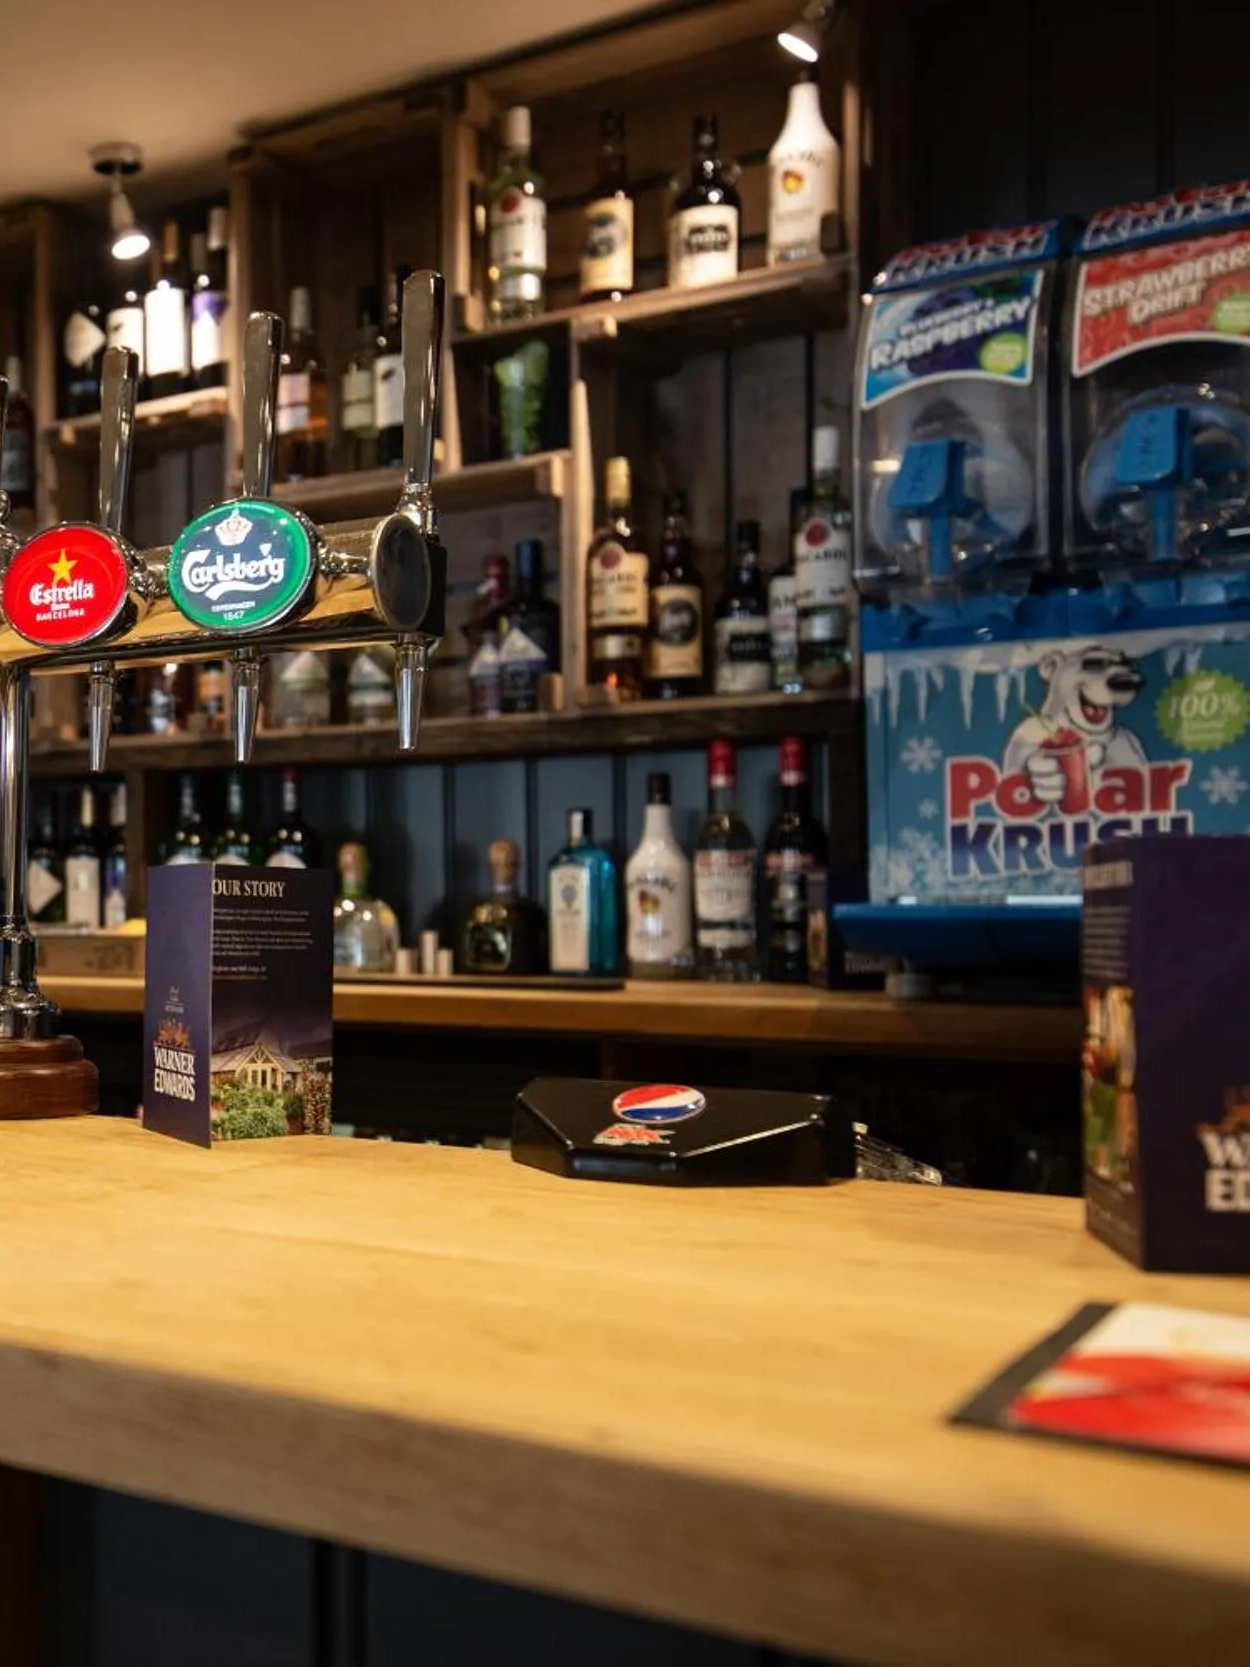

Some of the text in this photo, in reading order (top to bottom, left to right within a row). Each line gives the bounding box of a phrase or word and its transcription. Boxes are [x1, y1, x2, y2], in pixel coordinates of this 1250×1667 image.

[1128, 279, 1208, 324] DRIFT
[870, 295, 1033, 370] RASPBERRY
[181, 543, 286, 594] Carlsberg
[30, 579, 94, 606] Estrella
[35, 608, 85, 622] BARCELONA
[948, 757, 1192, 820] Polar
[213, 878, 286, 899] OUR STORY
[154, 1046, 196, 1077] WARNER
[154, 1068, 196, 1102] EDWARDS
